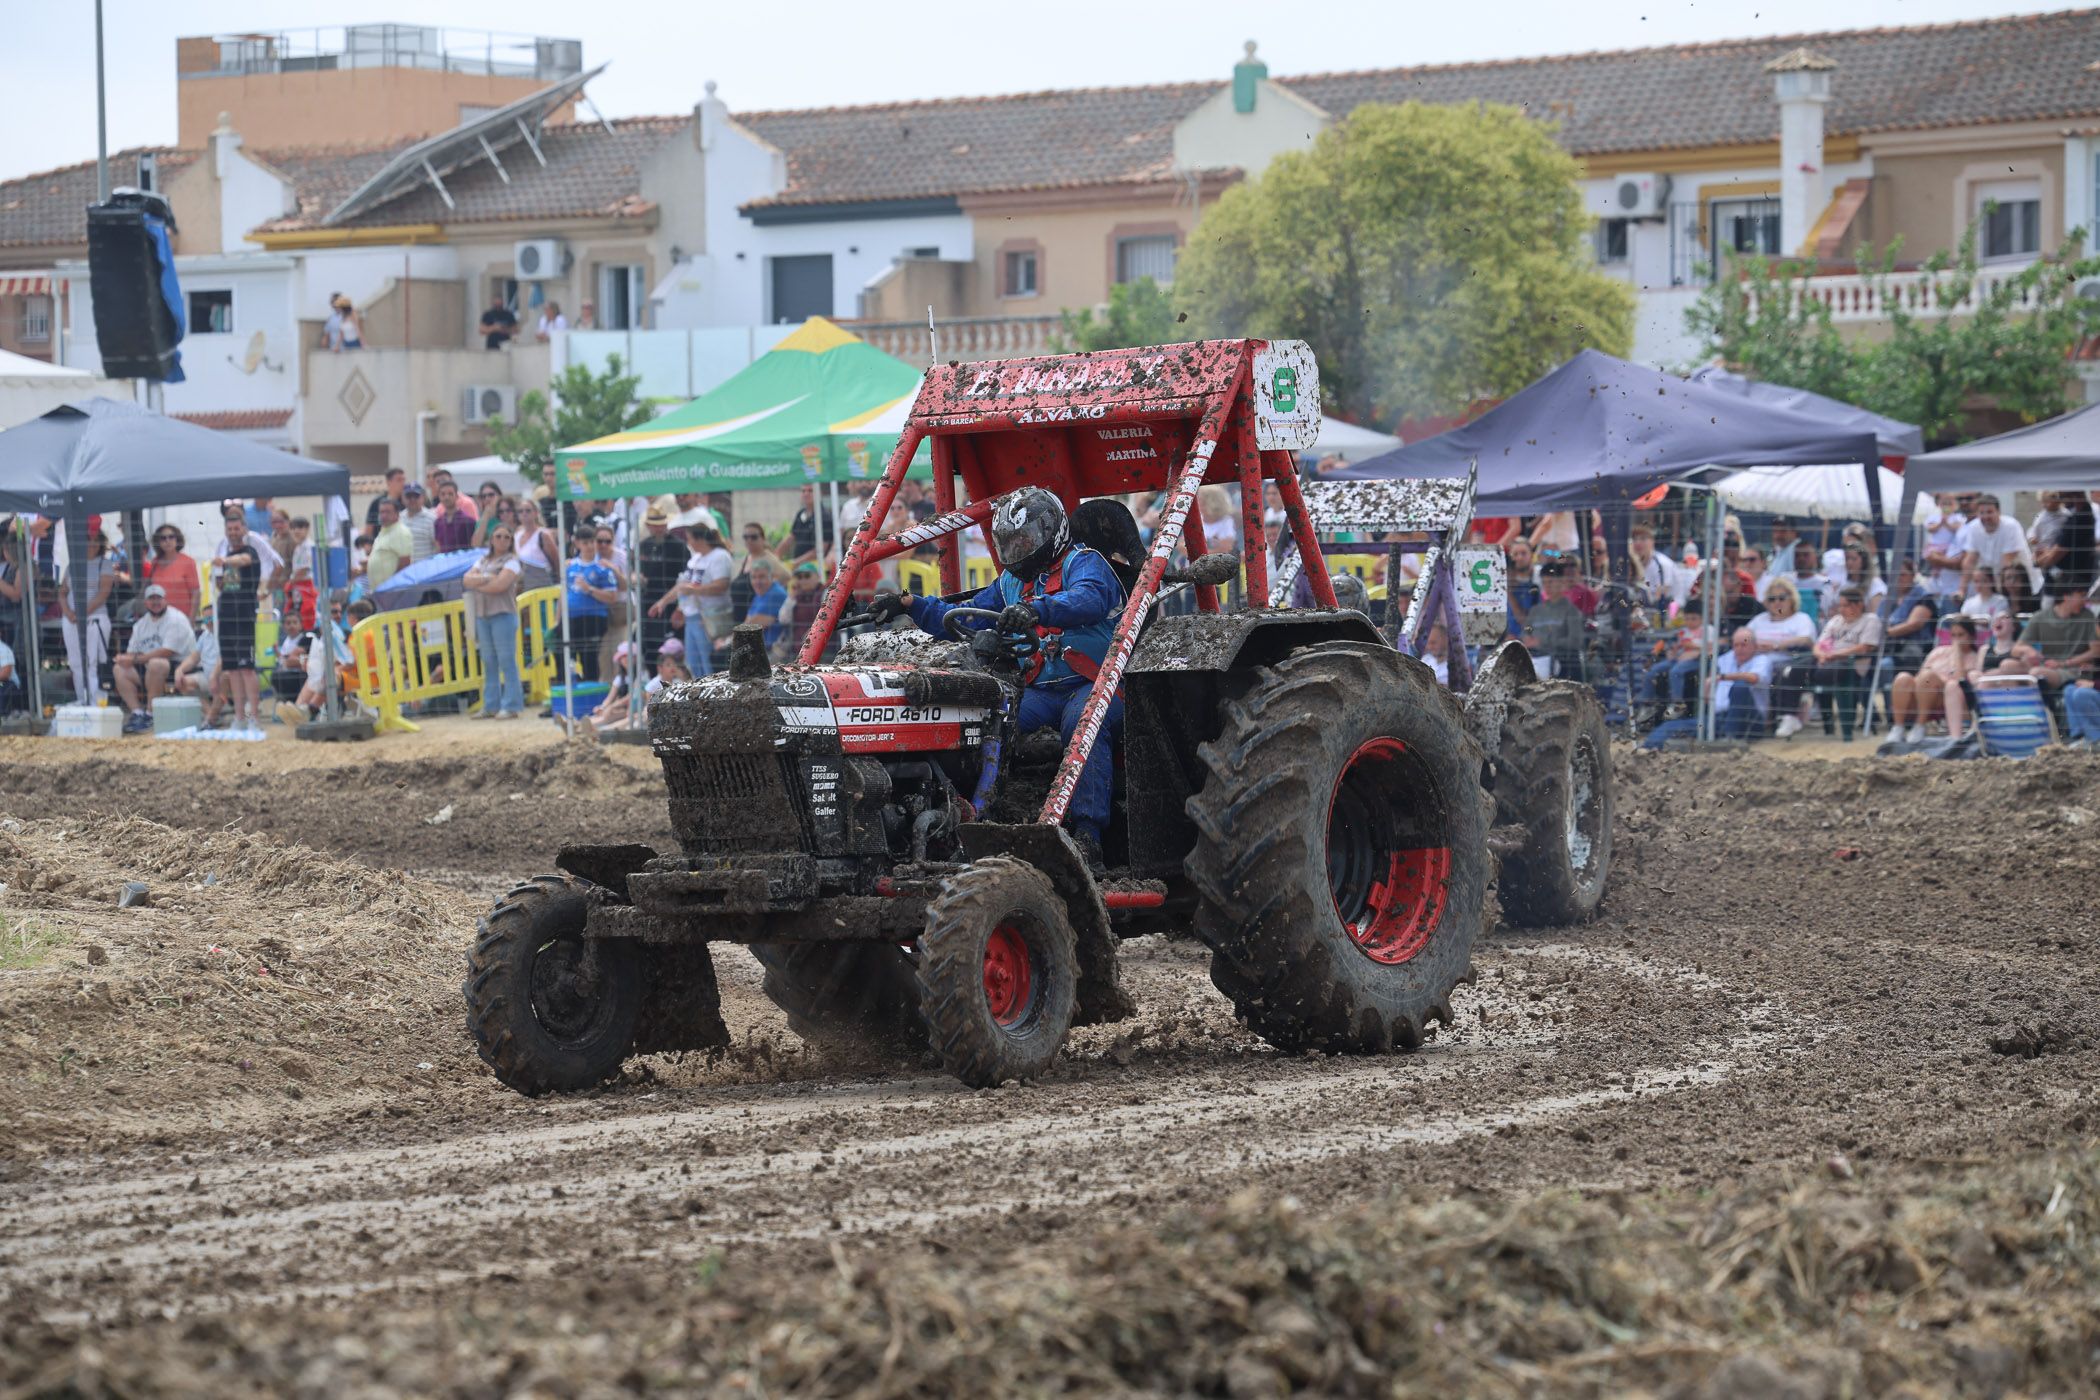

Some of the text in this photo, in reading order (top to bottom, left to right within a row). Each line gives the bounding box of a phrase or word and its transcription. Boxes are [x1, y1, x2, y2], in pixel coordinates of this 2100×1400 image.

[1097, 427, 1153, 440] VALERIA
[1106, 448, 1157, 461] MARTINA
[598, 466, 688, 488] Ayuntamiento
[689, 464, 706, 479] de
[1471, 560, 1491, 594] 6
[851, 706, 942, 723] FORD 4610
[780, 726, 821, 735] FORDTRCK
[815, 806, 837, 816] Galfer
